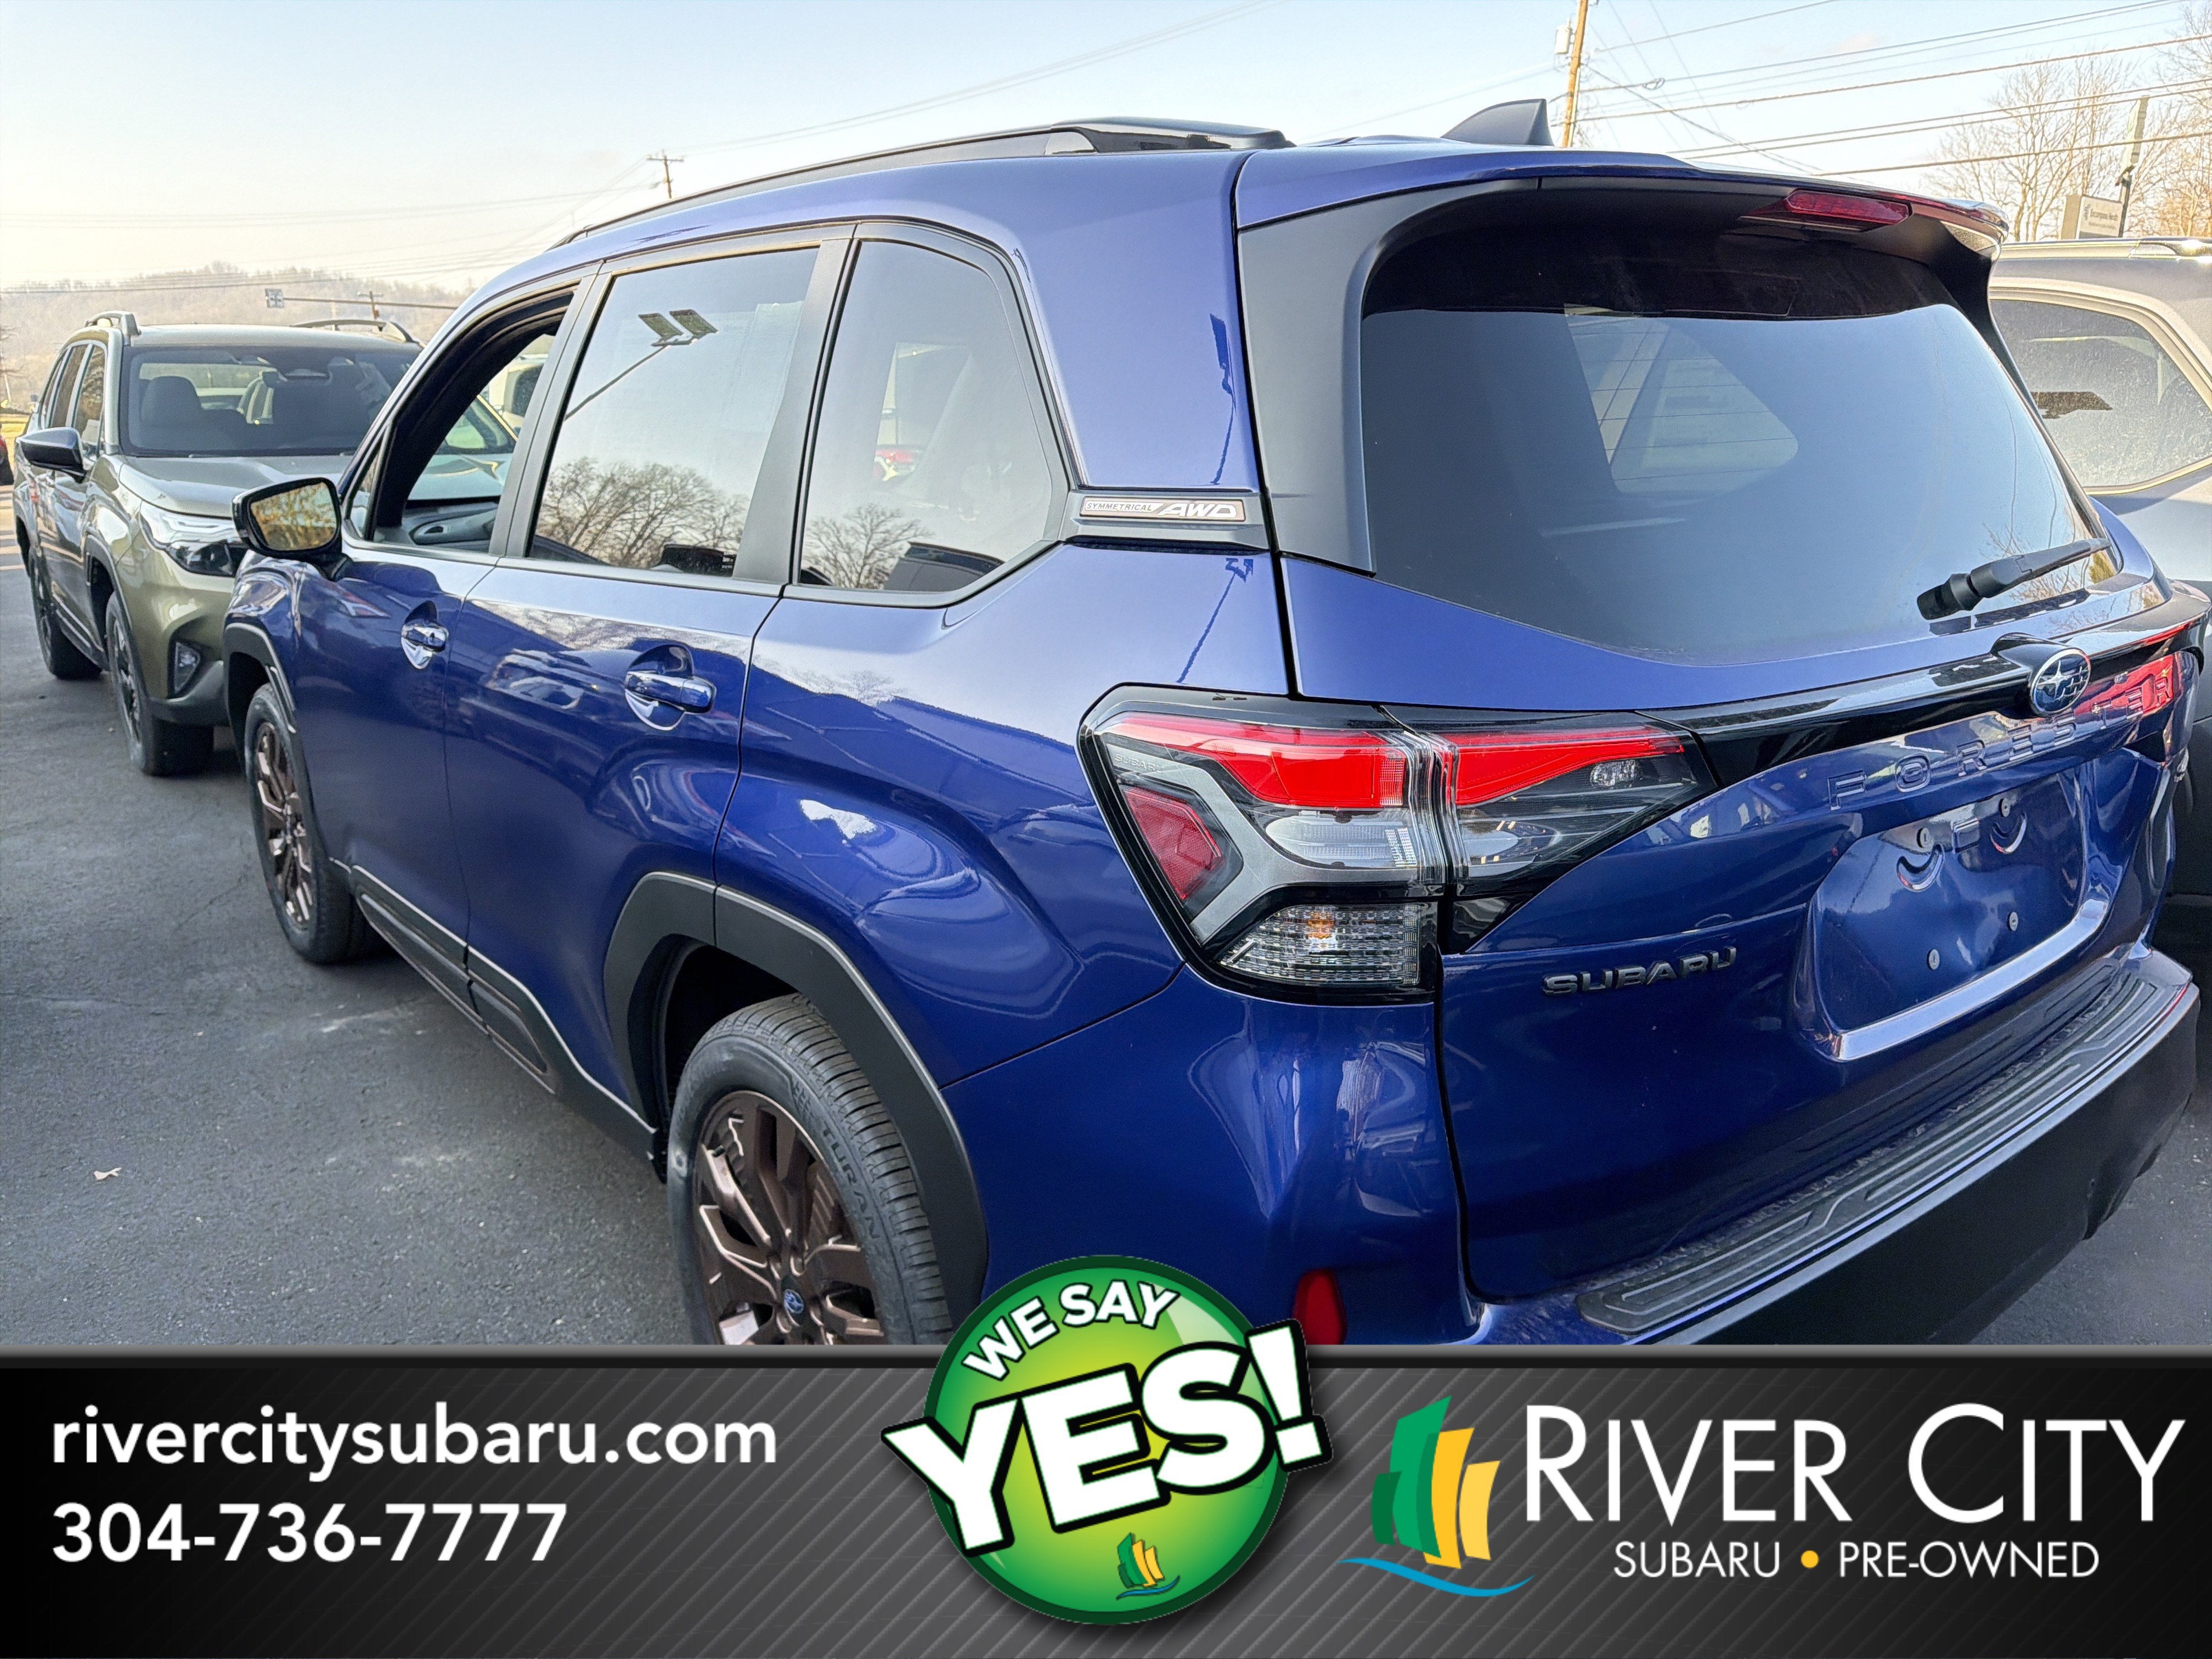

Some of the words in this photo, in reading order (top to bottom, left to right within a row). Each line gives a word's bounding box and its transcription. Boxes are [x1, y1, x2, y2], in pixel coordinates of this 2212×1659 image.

[1086, 503, 1153, 511] SYMMETRICAL
[1158, 503, 1237, 518] AWD
[1827, 677, 2172, 811] FORESTER
[1114, 753, 1165, 773] SUBARU
[1543, 946, 1737, 996] SUBARU
